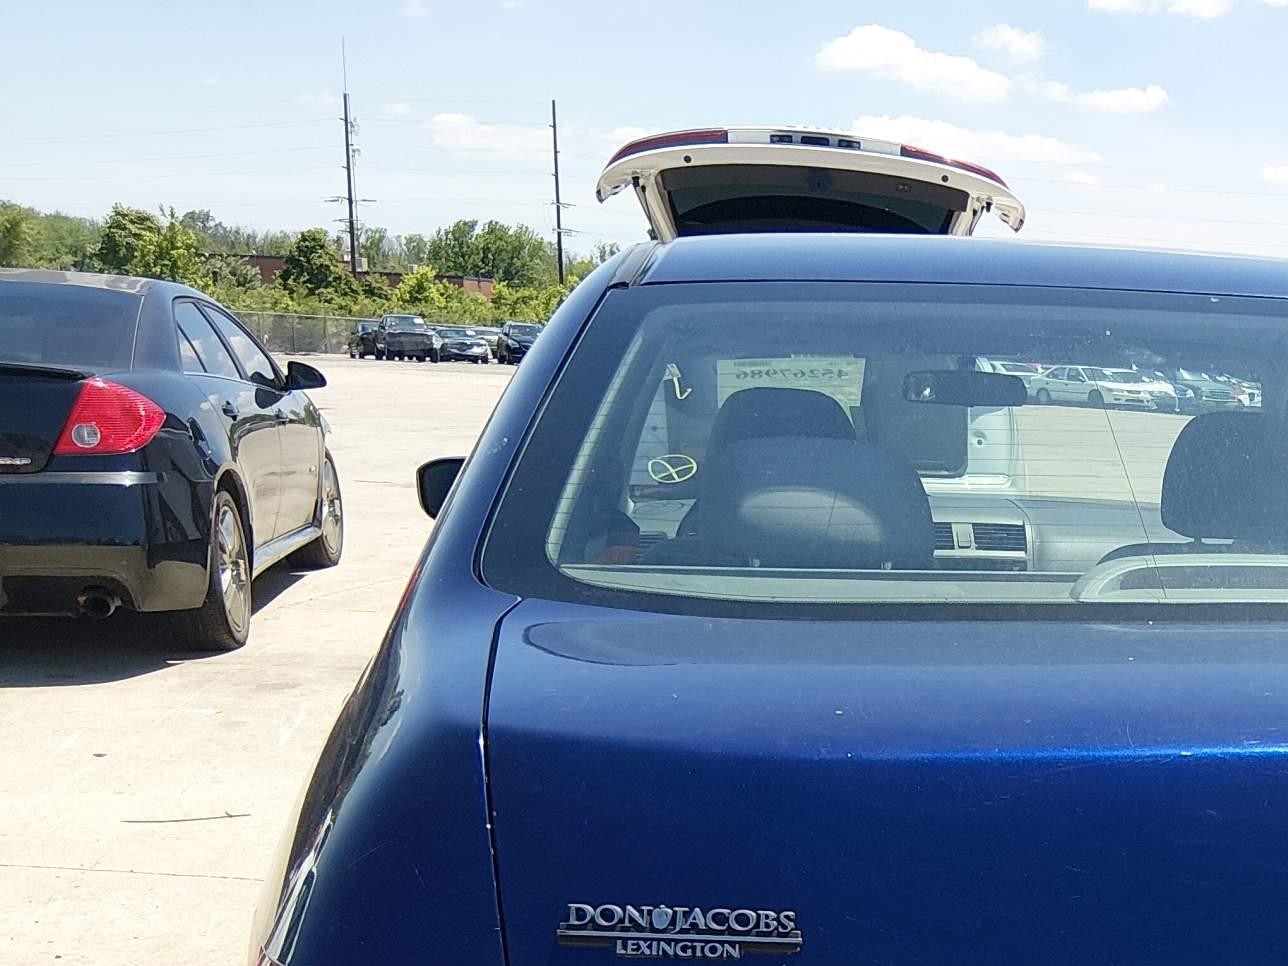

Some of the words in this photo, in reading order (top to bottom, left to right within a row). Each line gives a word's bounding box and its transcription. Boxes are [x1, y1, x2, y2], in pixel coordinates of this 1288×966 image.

[566, 903, 653, 927] DON
[669, 907, 796, 933] JACOBS
[616, 939, 741, 959] LEXINGTON
